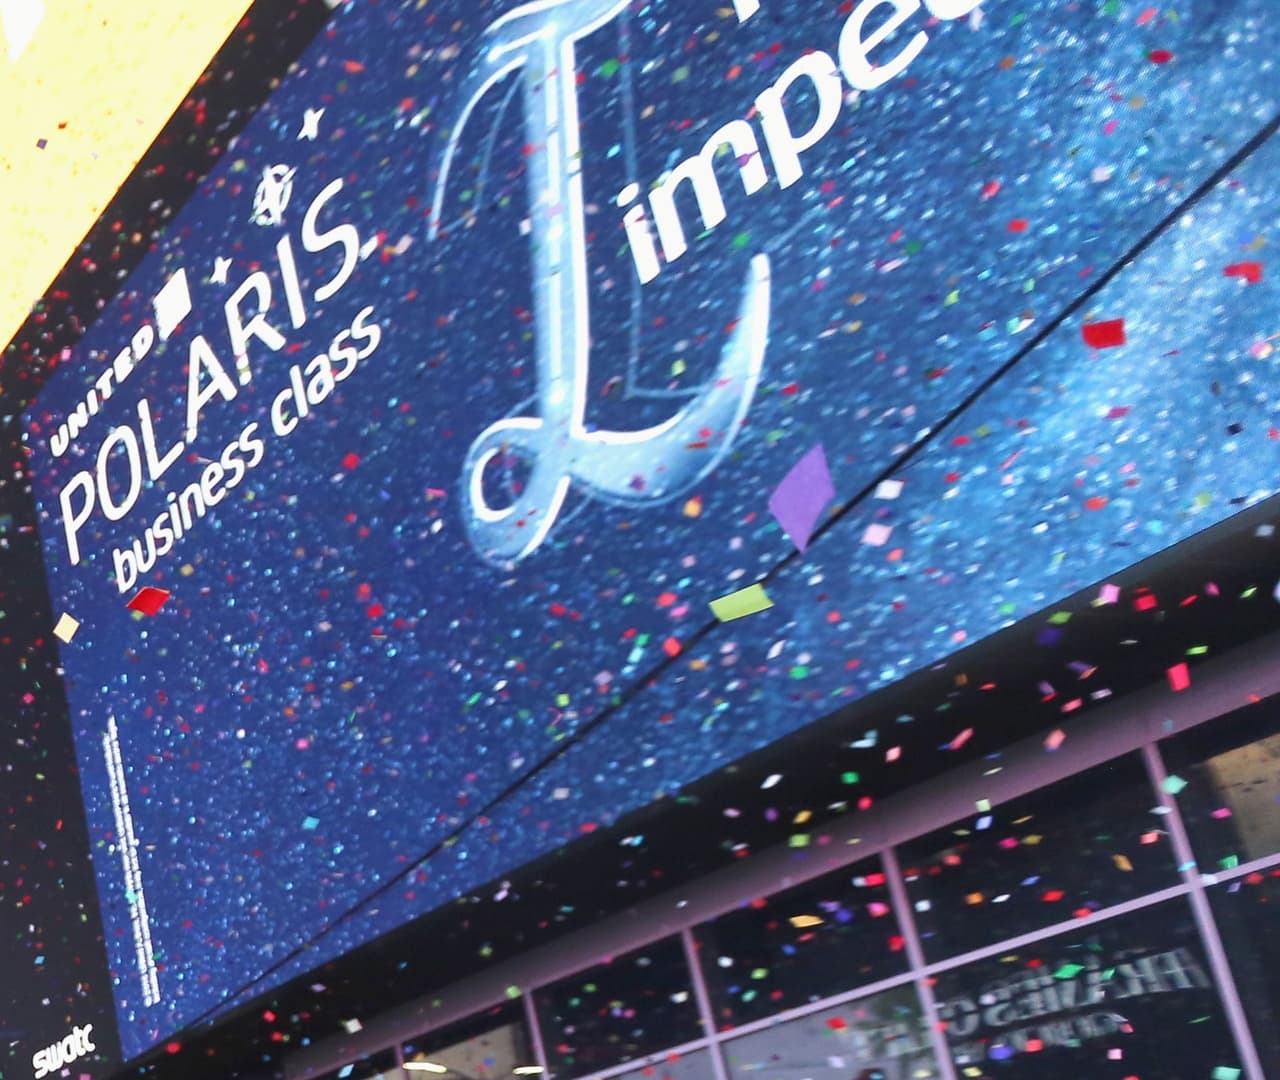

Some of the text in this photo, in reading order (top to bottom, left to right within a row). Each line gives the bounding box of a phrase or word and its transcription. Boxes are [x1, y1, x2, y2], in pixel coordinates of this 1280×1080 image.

[616, 0, 1000, 285] impe
[49, 326, 156, 458] UNITED
[59, 177, 362, 566] POLARIS
[113, 422, 265, 594] business
[268, 306, 382, 437] class
